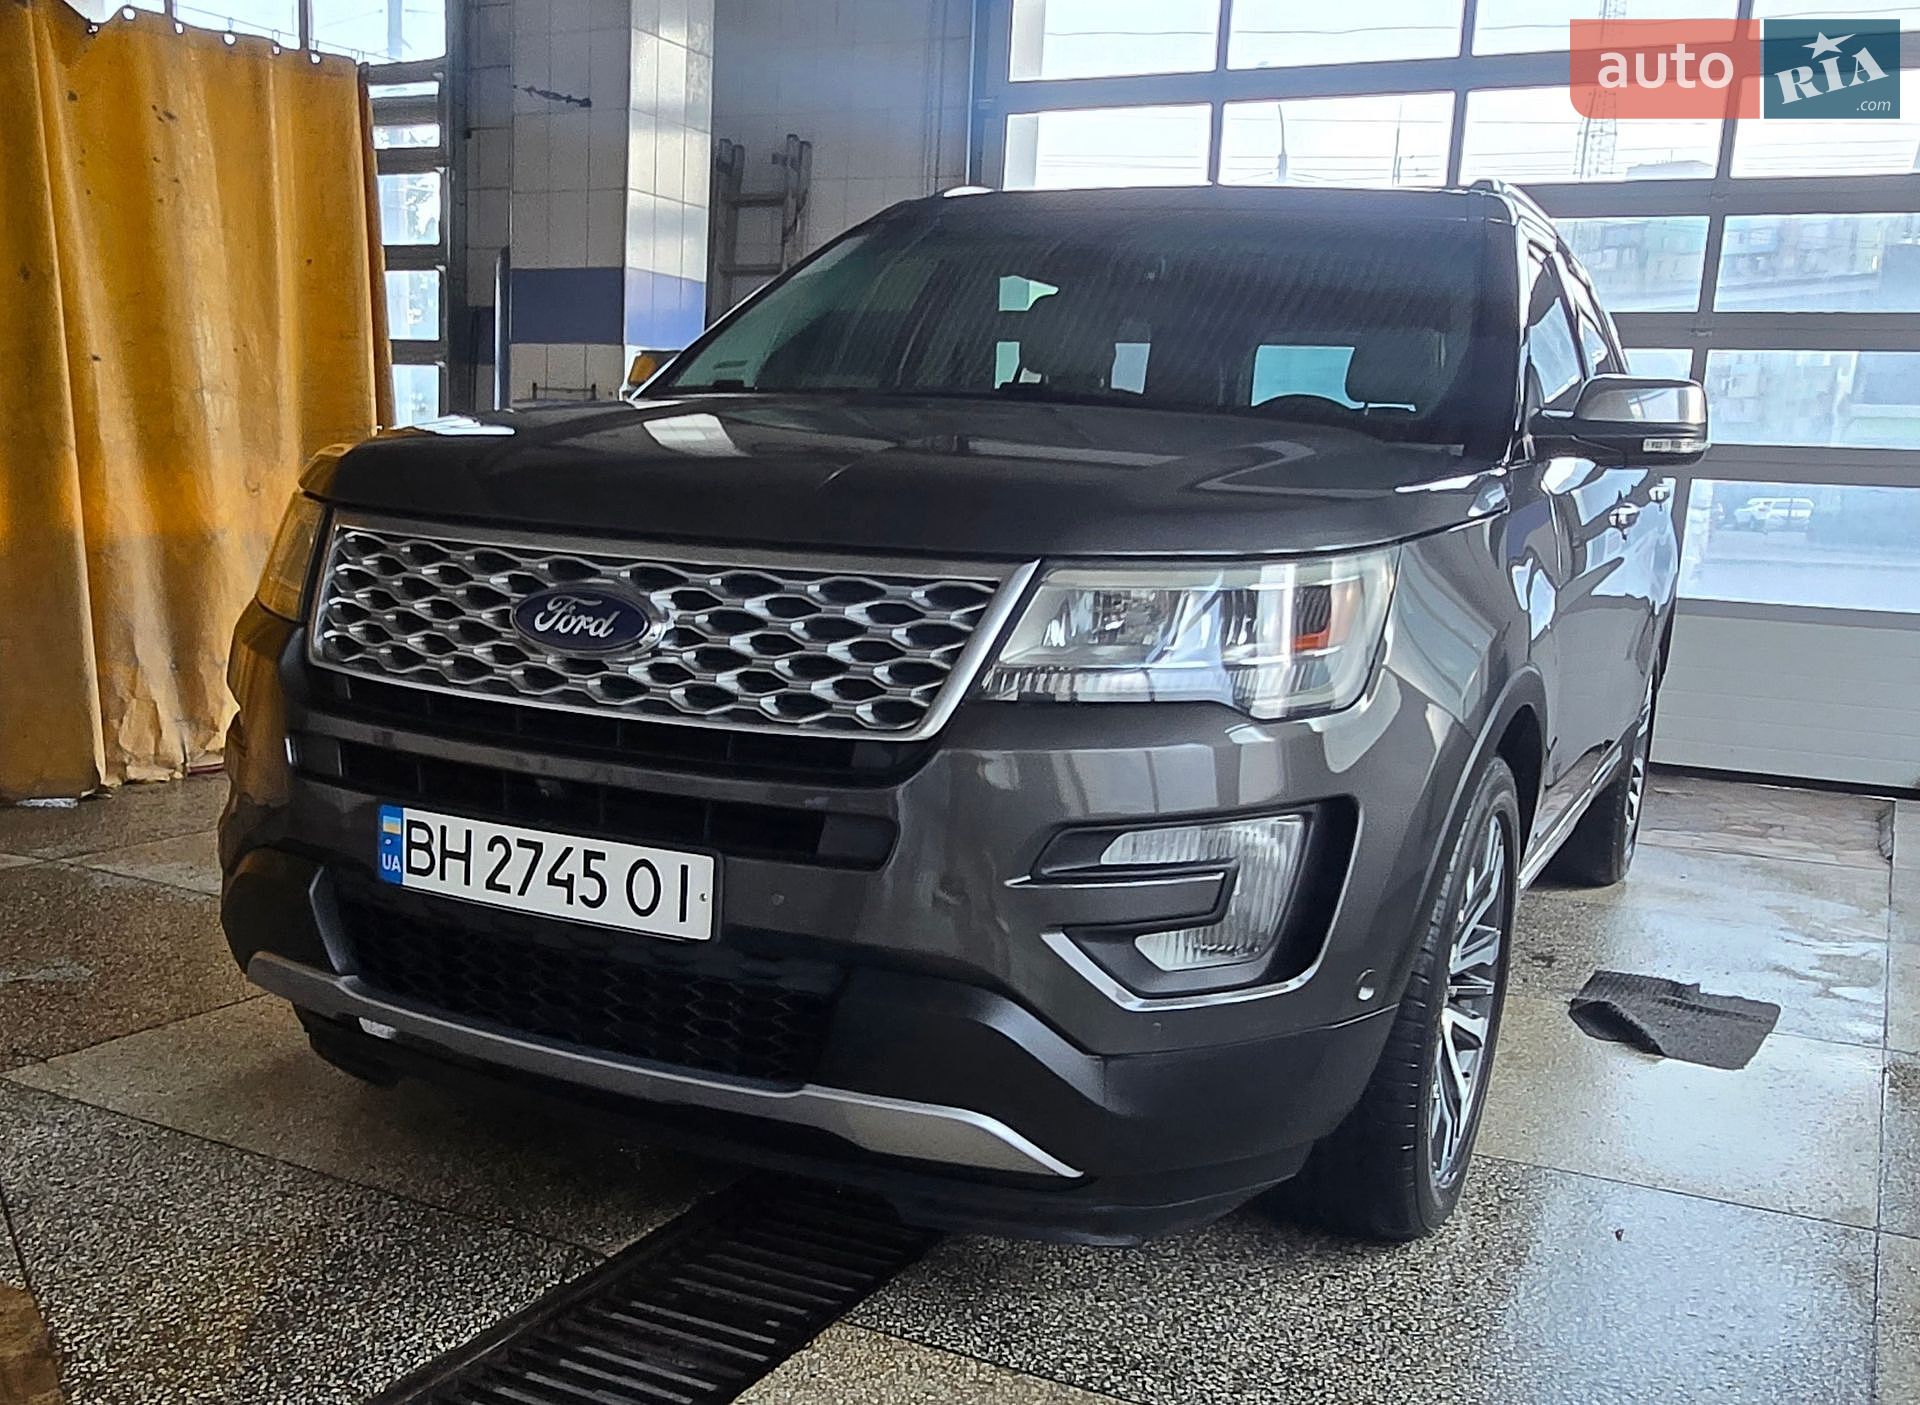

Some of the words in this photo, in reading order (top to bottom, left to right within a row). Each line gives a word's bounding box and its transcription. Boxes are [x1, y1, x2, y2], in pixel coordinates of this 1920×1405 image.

[534, 595, 620, 638] Ford
[382, 853, 401, 873] UA
[405, 819, 472, 886] BH
[485, 835, 608, 909] 2745
